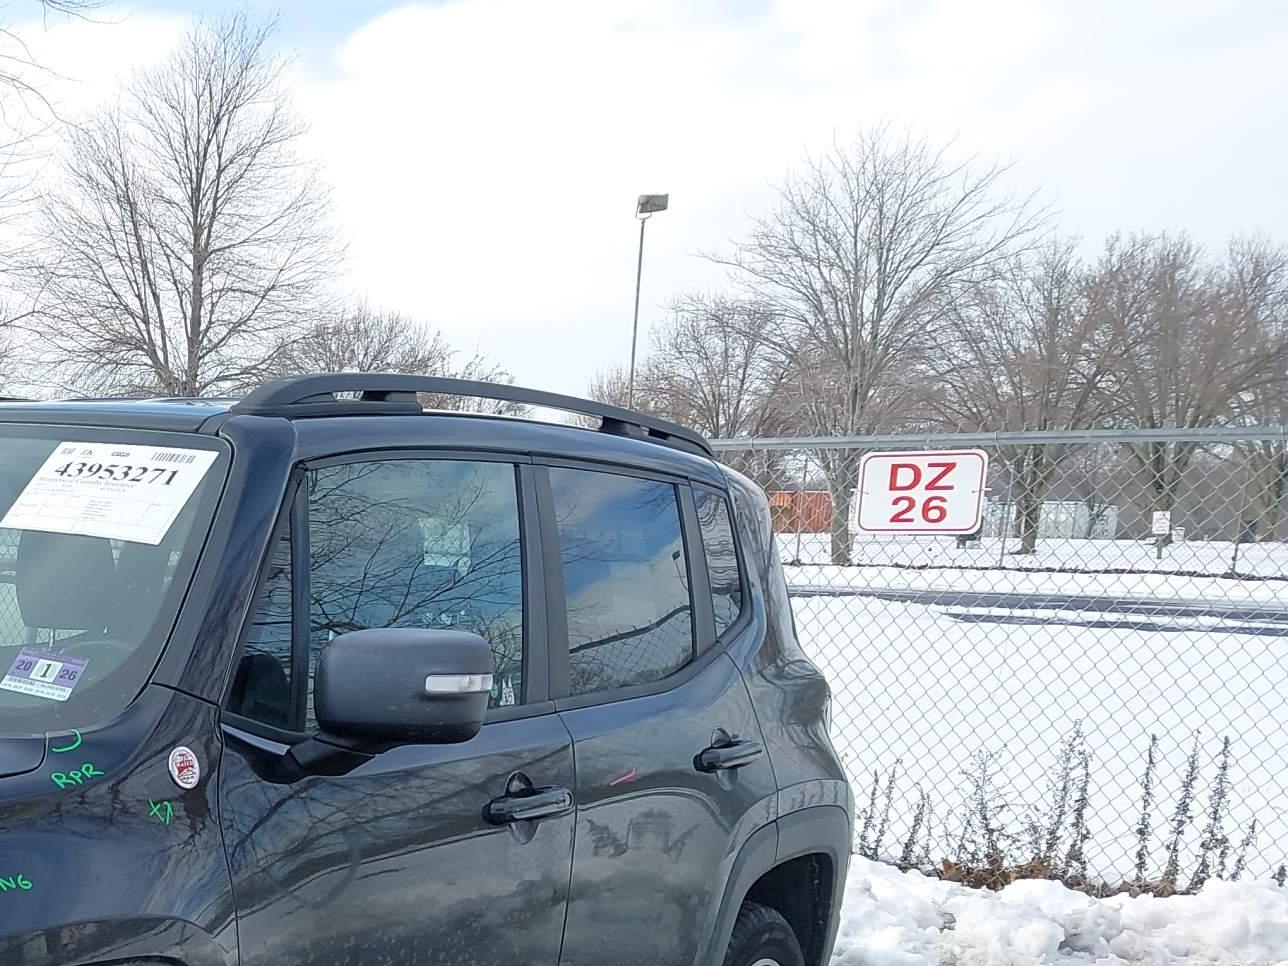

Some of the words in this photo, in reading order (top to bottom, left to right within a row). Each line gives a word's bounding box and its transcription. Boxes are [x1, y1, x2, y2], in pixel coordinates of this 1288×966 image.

[54, 461, 179, 486] 43953271
[889, 462, 957, 491] DZ
[889, 496, 948, 523] 26
[16, 660, 32, 671] 20
[40, 664, 52, 678] 1
[59, 670, 77, 680] 26
[51, 763, 104, 788] RPR
